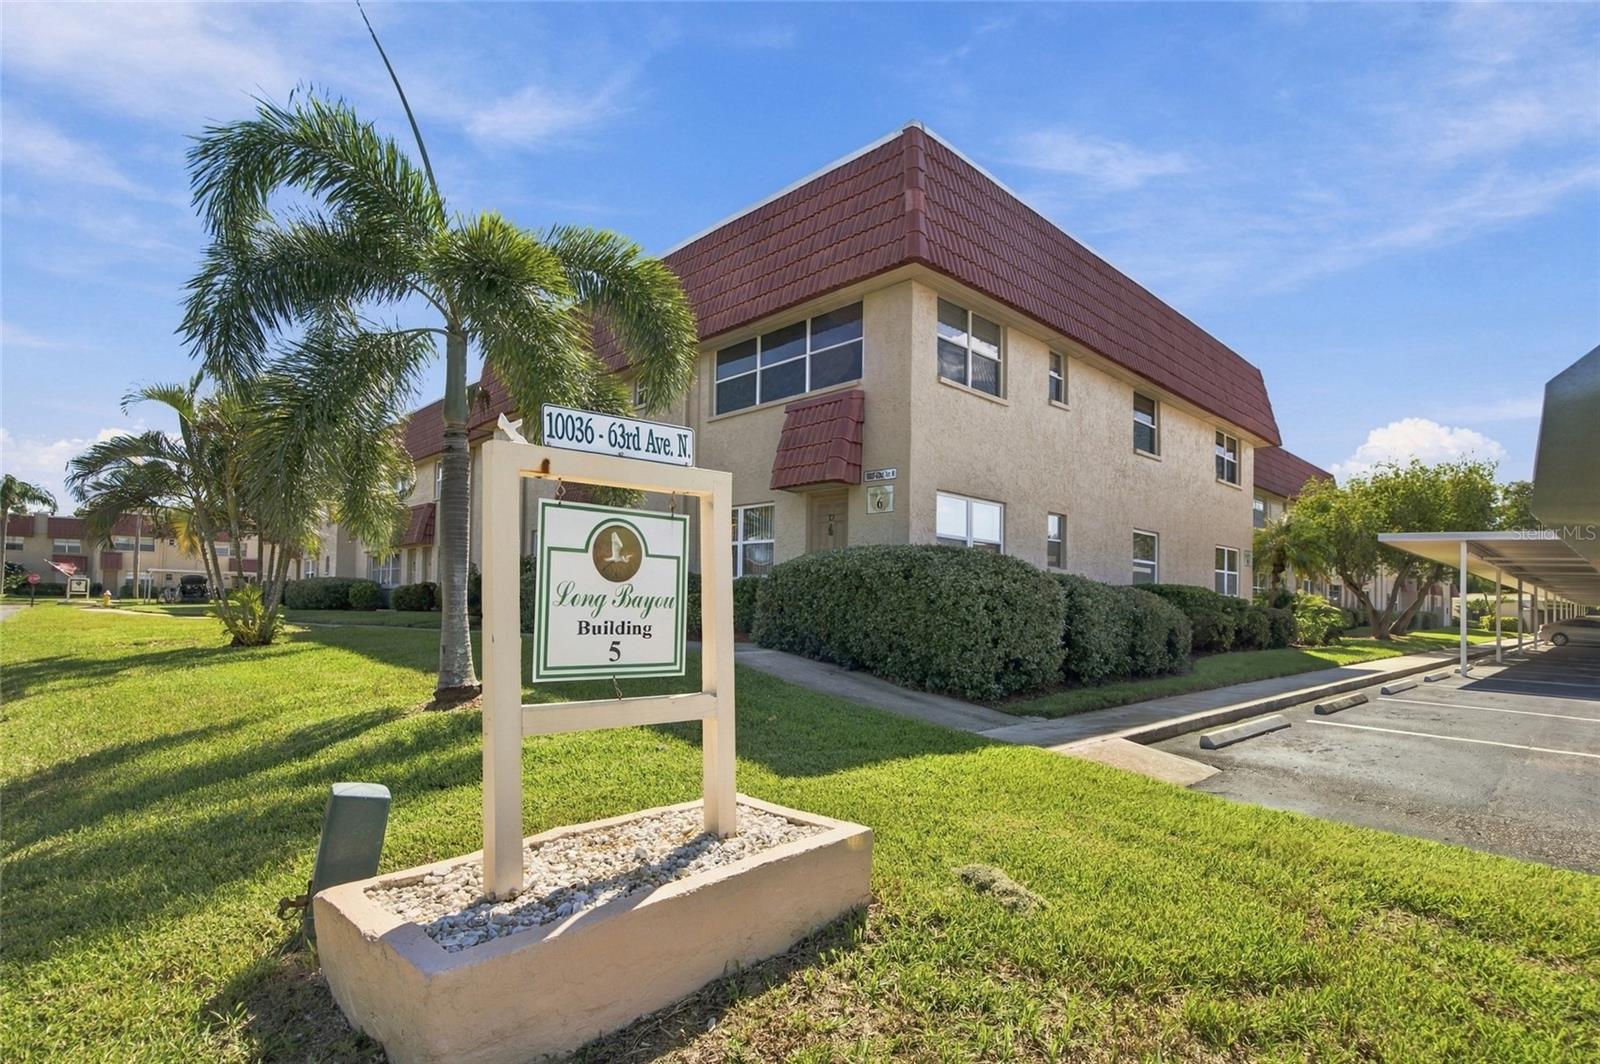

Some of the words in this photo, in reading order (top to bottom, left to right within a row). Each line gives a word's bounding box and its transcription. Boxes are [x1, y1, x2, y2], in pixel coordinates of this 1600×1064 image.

[546, 412, 595, 444] 10036
[608, 422, 642, 451] 63rd
[645, 428, 674, 457] Ave.
[677, 433, 691, 458] N.
[876, 495, 883, 509] 6
[552, 580, 608, 619] Long
[612, 583, 676, 619] Bayou
[577, 620, 652, 639] Building
[608, 641, 621, 662] 5
